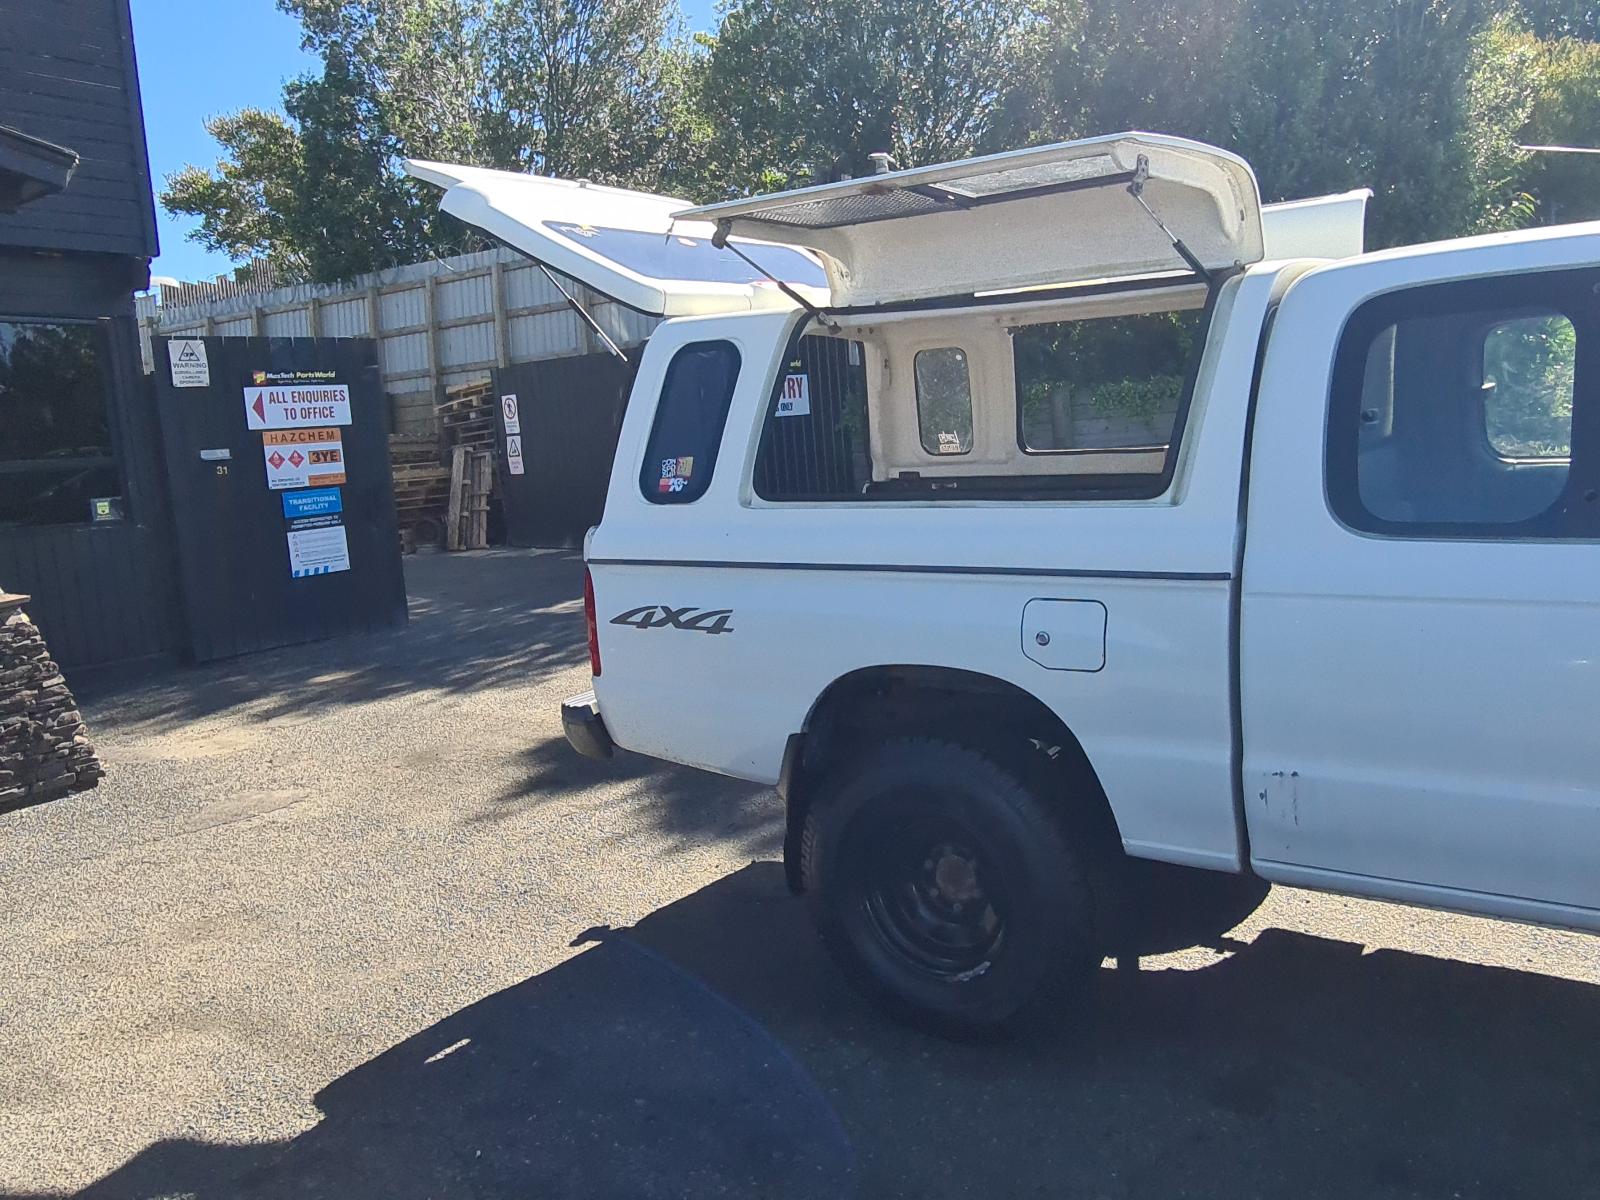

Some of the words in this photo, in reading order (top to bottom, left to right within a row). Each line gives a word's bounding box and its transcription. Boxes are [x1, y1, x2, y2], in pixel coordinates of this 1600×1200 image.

[268, 391, 289, 405] ALL
[291, 389, 346, 404] ENQUIRIES
[283, 407, 298, 421] TO
[300, 406, 336, 420] OFFICE
[270, 430, 335, 443] HAZCHEM
[312, 450, 339, 463] 3YE
[216, 465, 228, 475] 31
[288, 495, 337, 506] TRANSITIONAL
[299, 502, 329, 511] FACILITY
